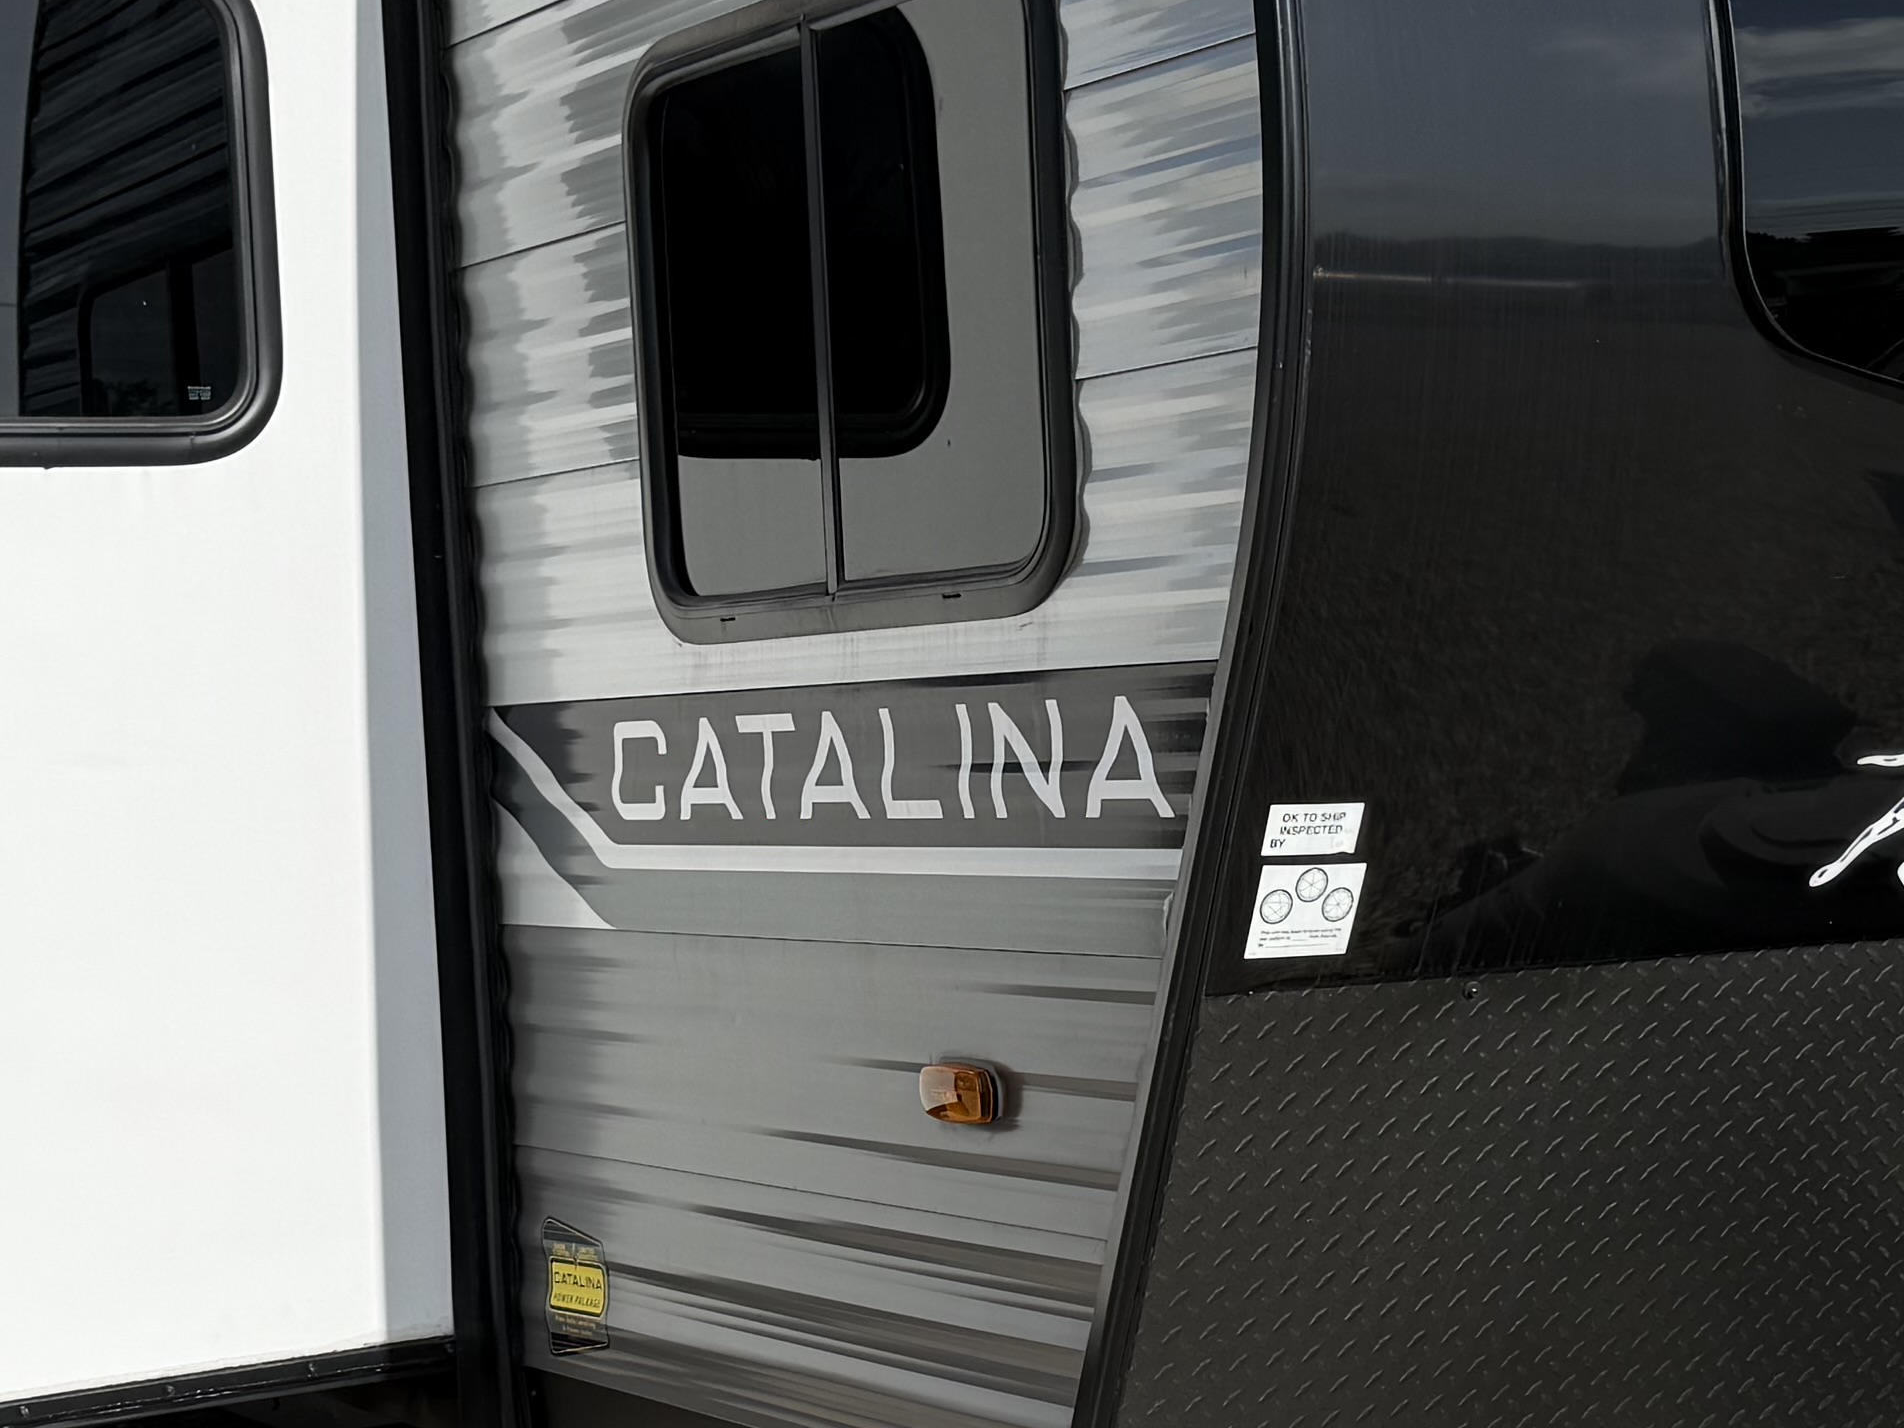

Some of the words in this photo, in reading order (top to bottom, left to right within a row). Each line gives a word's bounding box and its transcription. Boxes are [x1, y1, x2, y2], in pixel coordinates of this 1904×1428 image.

[610, 695, 1176, 821] CATALINA
[1282, 813, 1299, 823] OK
[1304, 813, 1317, 822] TO
[1279, 825, 1344, 836] INSPECTED
[1269, 839, 1286, 848] BY
[554, 1272, 603, 1290] CATALINA
